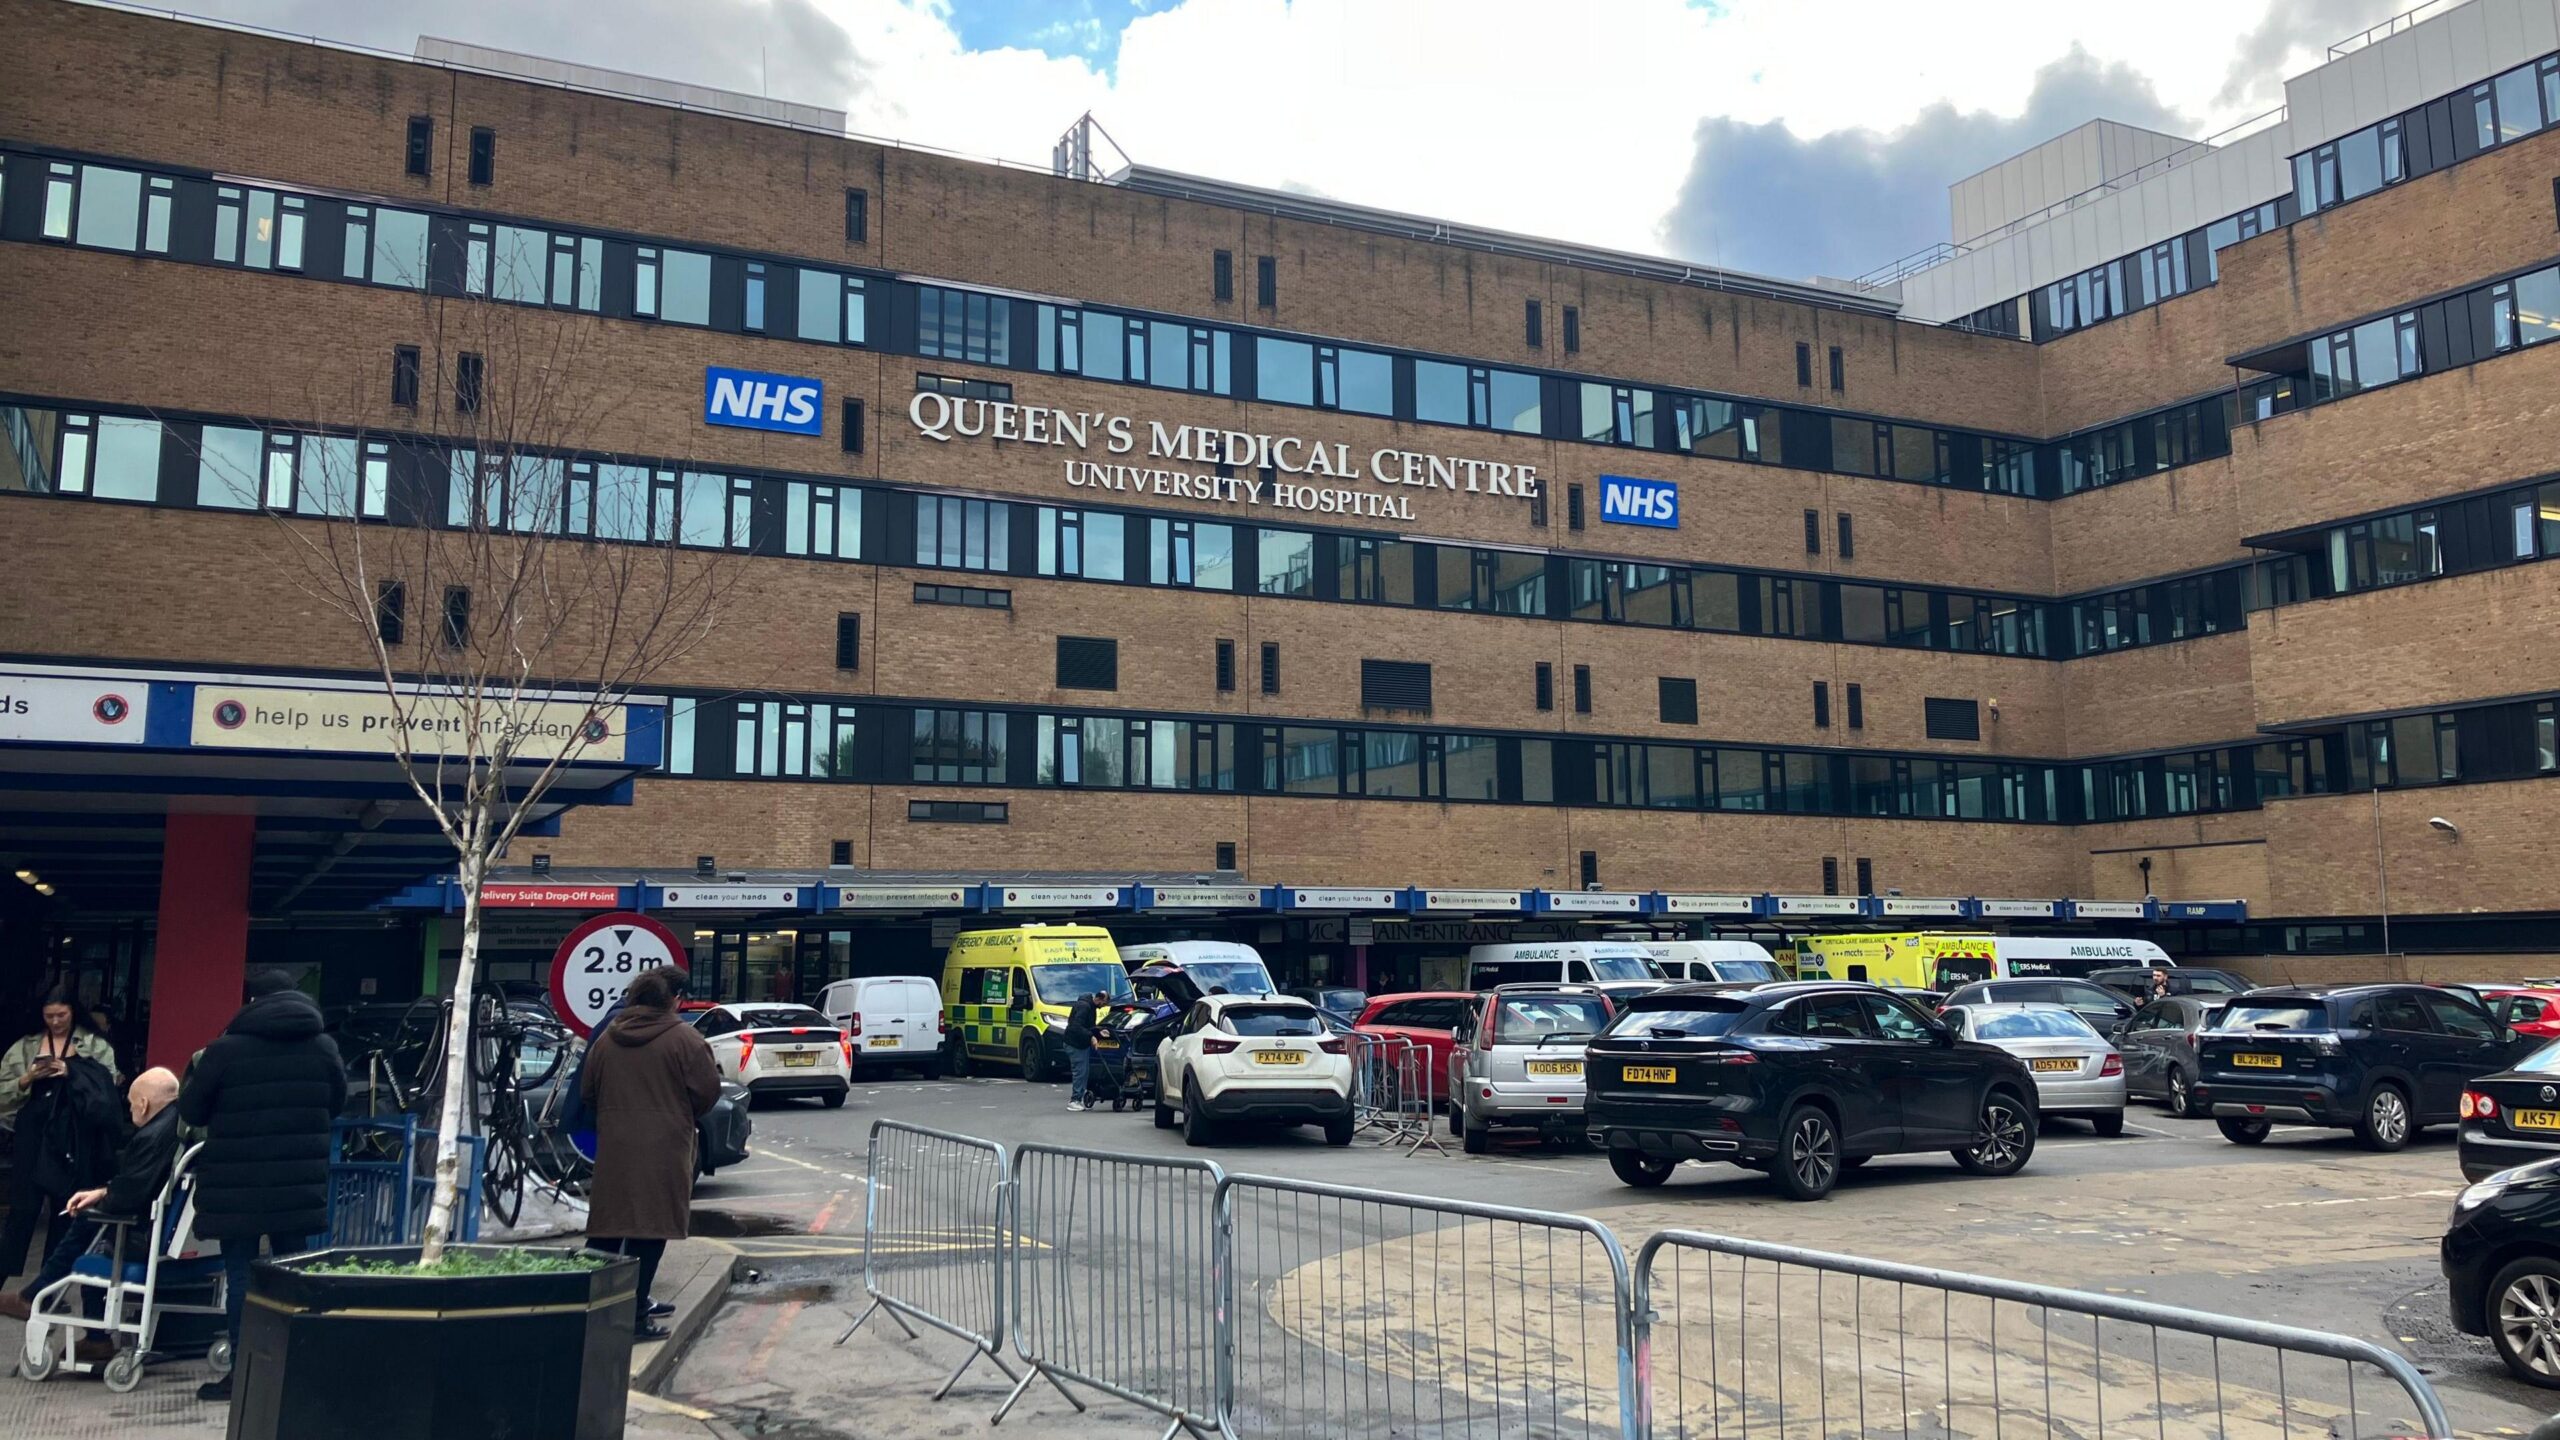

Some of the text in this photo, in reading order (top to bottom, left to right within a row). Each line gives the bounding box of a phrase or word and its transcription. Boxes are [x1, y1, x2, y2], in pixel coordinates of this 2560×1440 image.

[710, 377, 818, 425] NHS
[1149, 421, 1359, 479] MEDICAL
[1370, 448, 1538, 498] CENTRE
[1064, 460, 1415, 520] UNIVERSITY HOSPITAL
[1605, 483, 1675, 520] NHS
[255, 706, 309, 730] help
[322, 710, 349, 728] us
[362, 714, 460, 733] prevent
[519, 890, 543, 901] Suite
[546, 891, 587, 902] Drop-Off
[590, 891, 615, 901] Point
[695, 891, 767, 903] clean your hands
[887, 893, 915, 902] prevent
[918, 892, 948, 901] infection
[1168, 892, 1181, 901] help
[1193, 894, 1218, 902] prevent
[1220, 893, 1247, 901] infection
[2187, 907, 2206, 915] RAMP
[1374, 923, 1411, 941] AIN
[1906, 938, 1919, 946] NHS
[1941, 942, 1988, 952] AMBULANCE
[1514, 950, 1559, 960] AMBULANCE
[2070, 946, 2133, 957] AMBULANCE
[584, 947, 632, 973] 2.8
[2031, 963, 2051, 971] Medical
[1257, 1051, 1300, 1062] FX74 XFA
[2237, 1054, 2278, 1065] BL23 HRE
[1560, 1063, 1578, 1073] HSA
[1627, 1068, 1671, 1080] FD74 HNF
[2522, 1111, 2556, 1126] AK57
